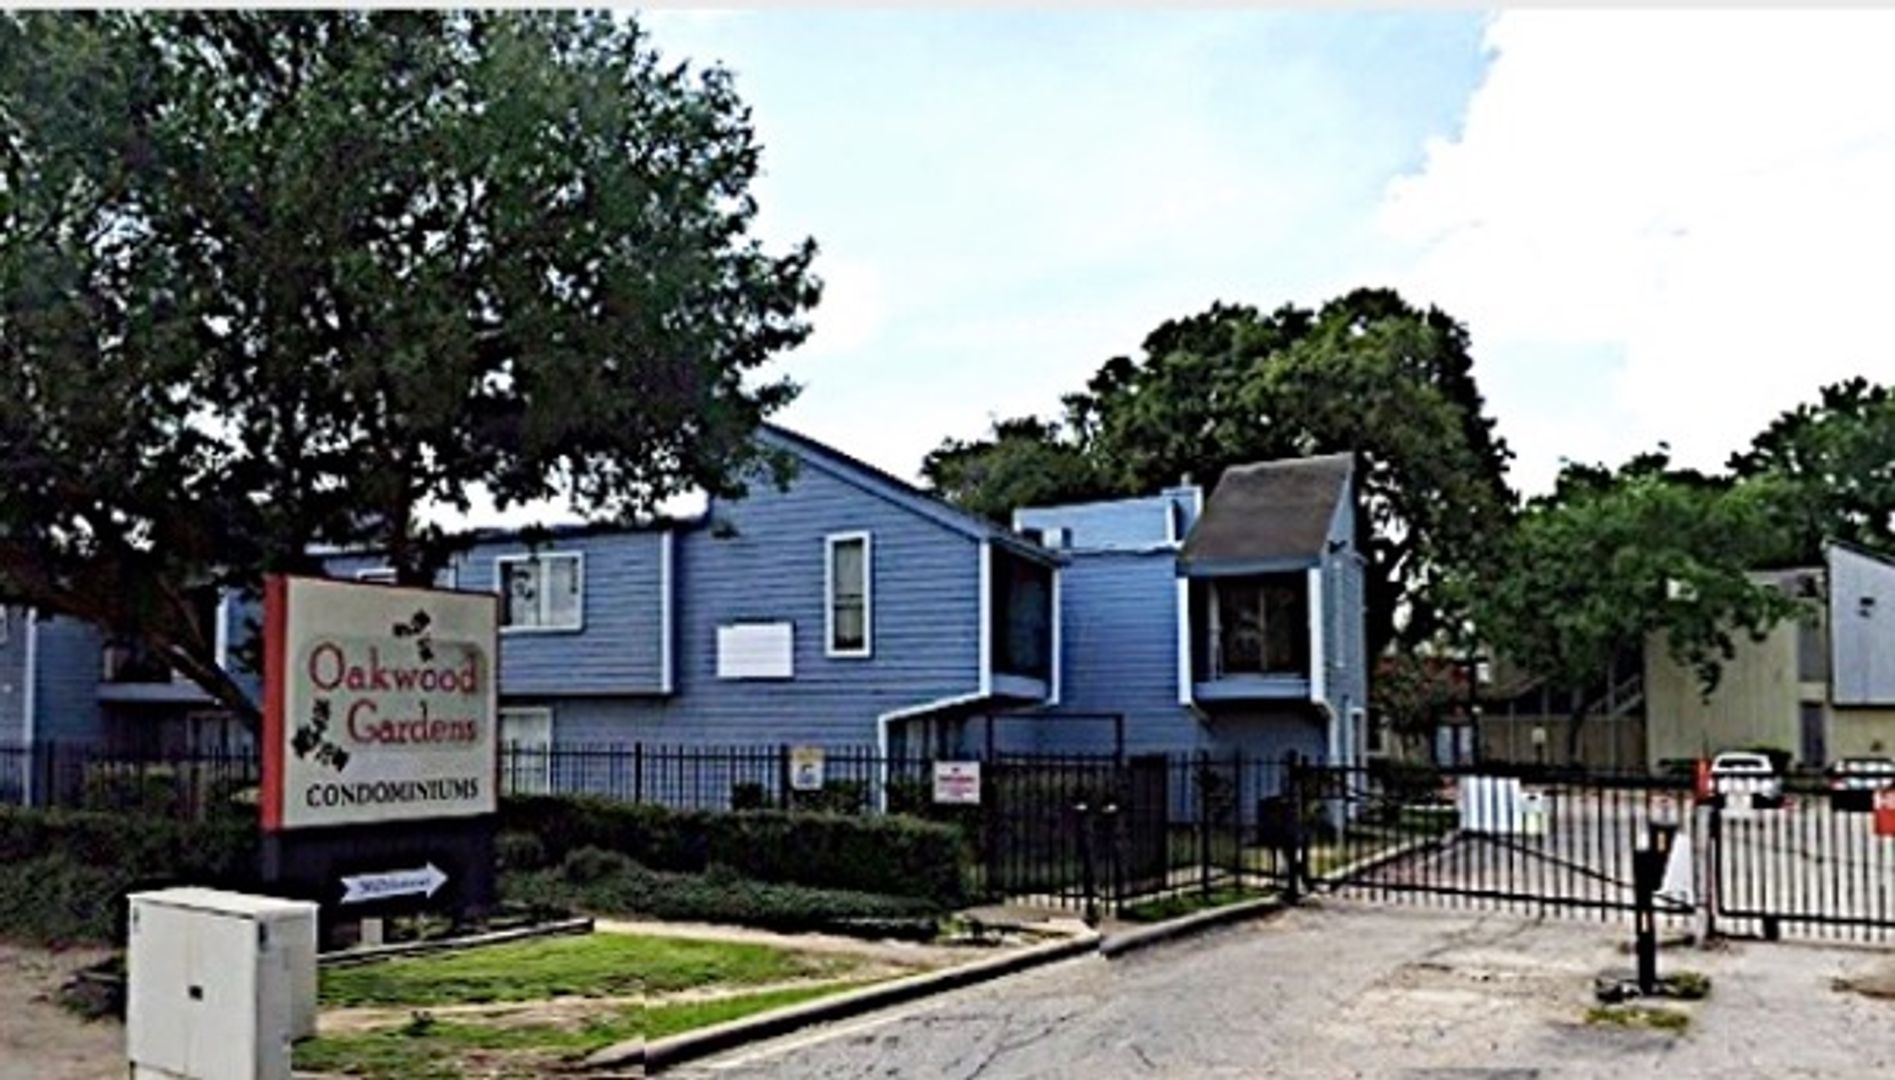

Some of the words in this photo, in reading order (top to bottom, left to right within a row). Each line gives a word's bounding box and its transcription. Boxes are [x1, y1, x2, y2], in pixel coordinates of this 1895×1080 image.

[309, 642, 478, 693] Oakwood
[346, 699, 478, 745] Gardens
[306, 777, 479, 808] CONDOMINIUMS
